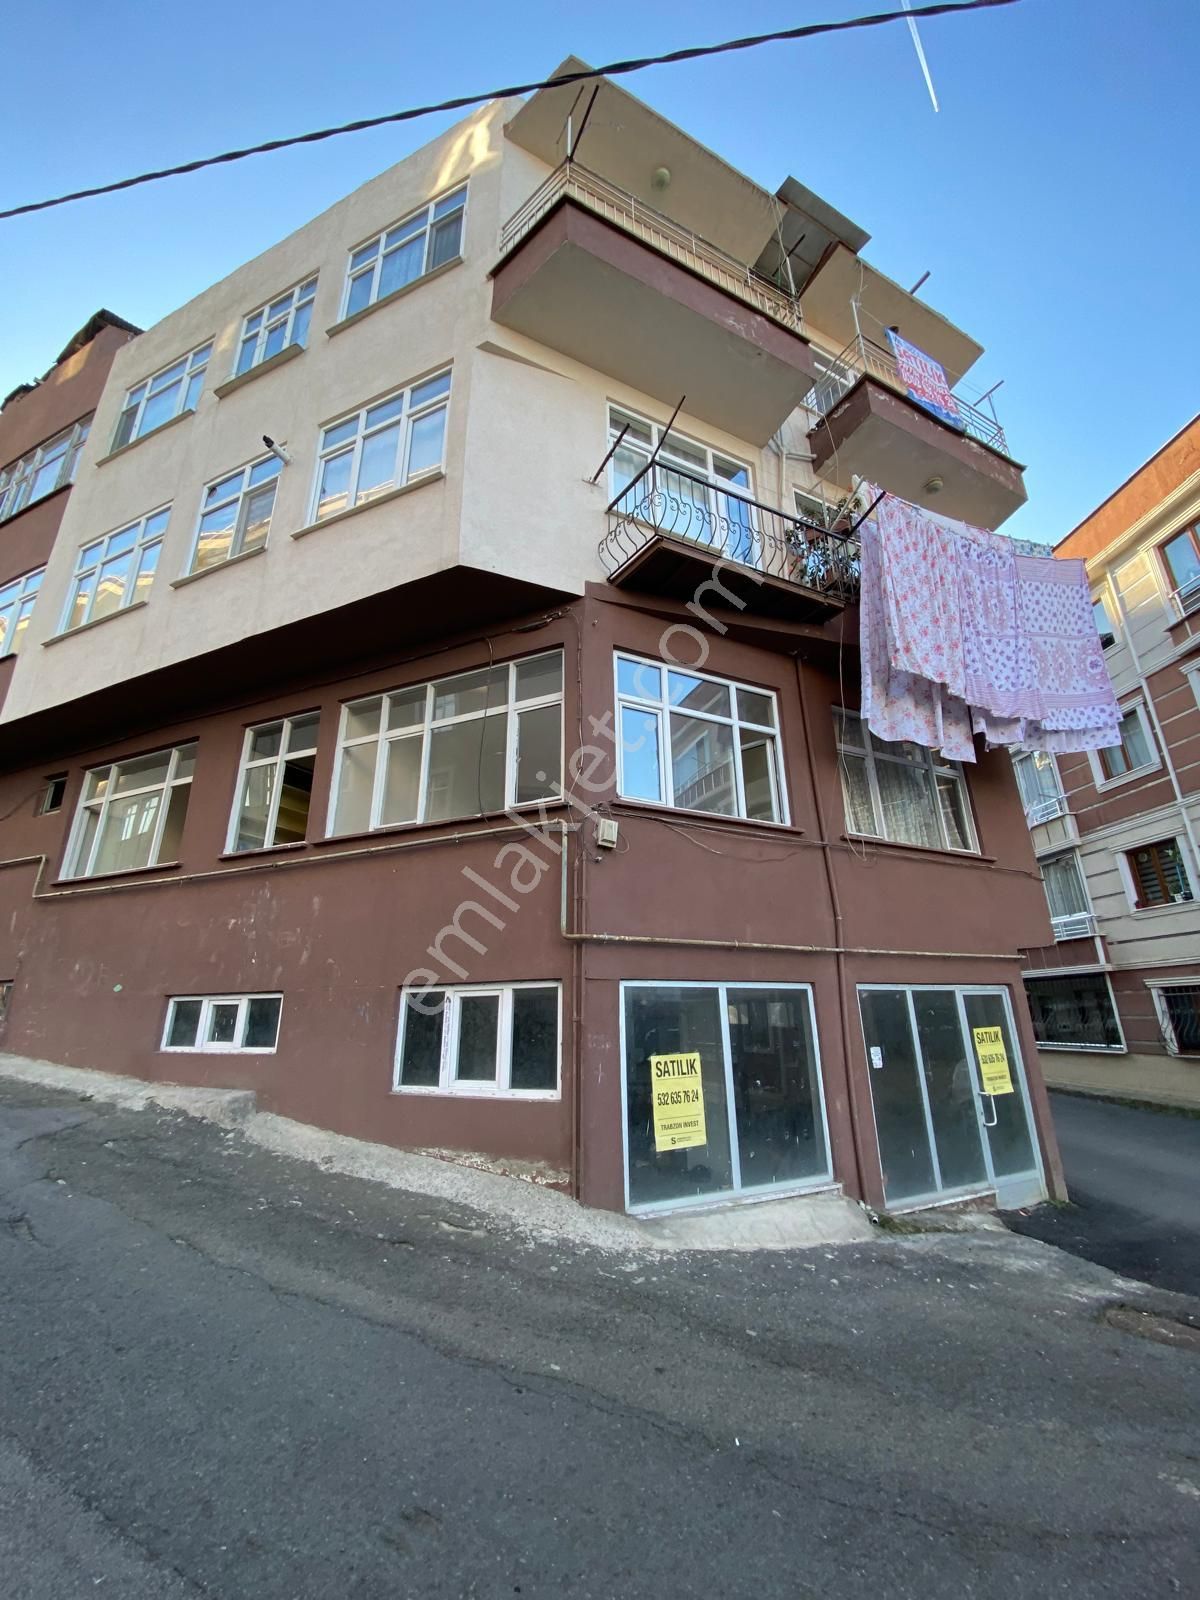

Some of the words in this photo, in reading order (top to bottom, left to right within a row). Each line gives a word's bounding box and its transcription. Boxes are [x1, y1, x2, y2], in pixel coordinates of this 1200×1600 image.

[976, 1031, 1000, 1044] SATILIK
[655, 1059, 697, 1077] SATILIK
[657, 1093, 670, 1106] 532
[670, 1091, 682, 1104] 635
[682, 1090, 690, 1103] 76
[691, 1089, 699, 1102] 24
[661, 1123, 682, 1131] TRABZON
[683, 1120, 699, 1128] INVEST
